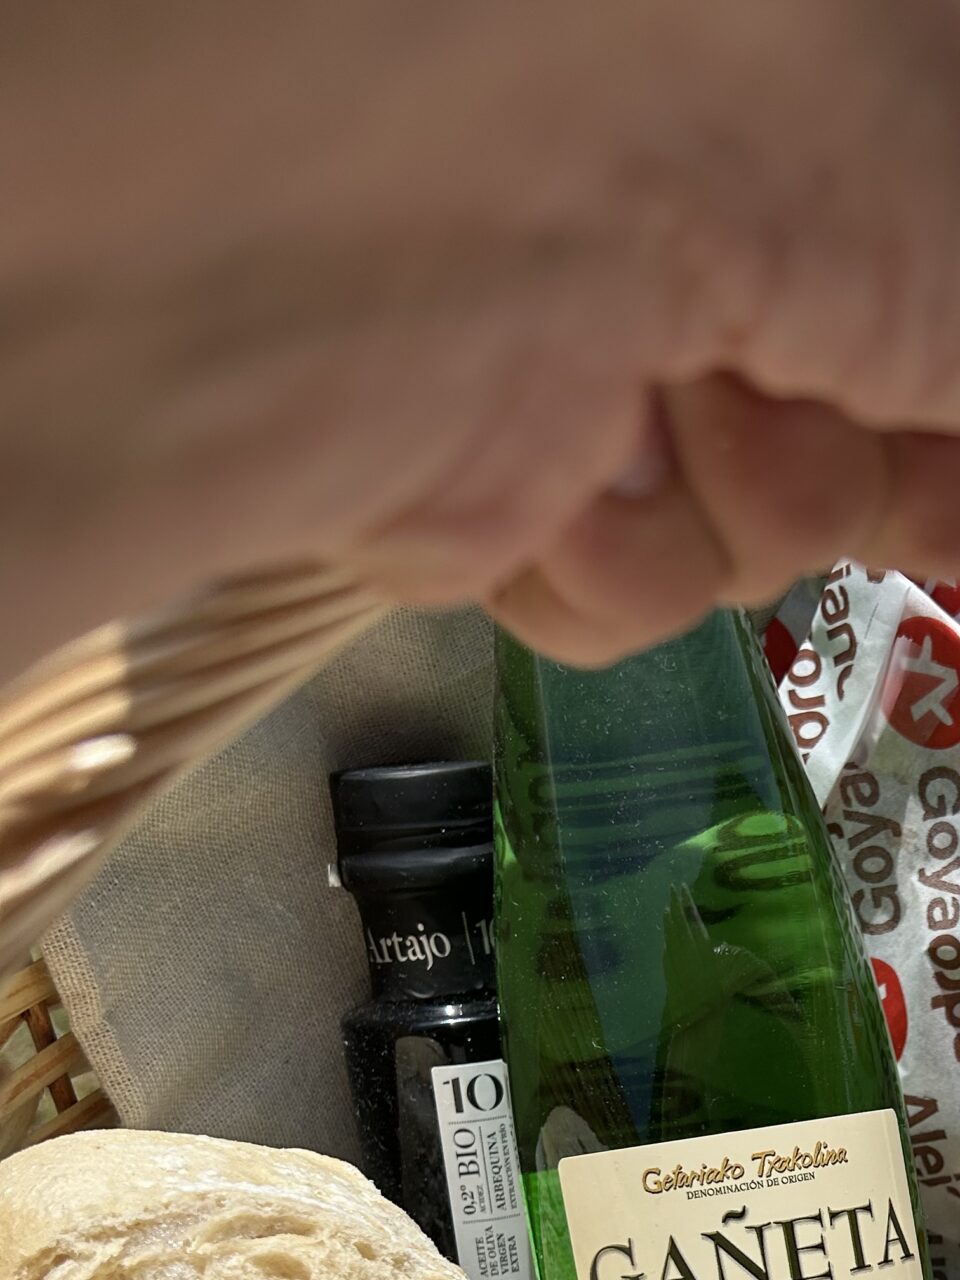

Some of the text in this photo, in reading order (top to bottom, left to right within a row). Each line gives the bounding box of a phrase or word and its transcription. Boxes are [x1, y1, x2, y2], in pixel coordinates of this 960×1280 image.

[839, 771, 902, 936] Goya
[442, 1073, 504, 1115] 10
[453, 1128, 481, 1179] BIO
[486, 1131, 507, 1212] ARBEQUINA
[641, 1141, 849, 1194] Getariako Txakolina
[686, 1171, 816, 1200] DENOMINACIÓN DE ORIGEN
[475, 1236, 489, 1278] ACEITE
[485, 1225, 500, 1277] DE OLIVA
[496, 1232, 510, 1276] VIRGEN
[508, 1235, 520, 1273] EXTRA
